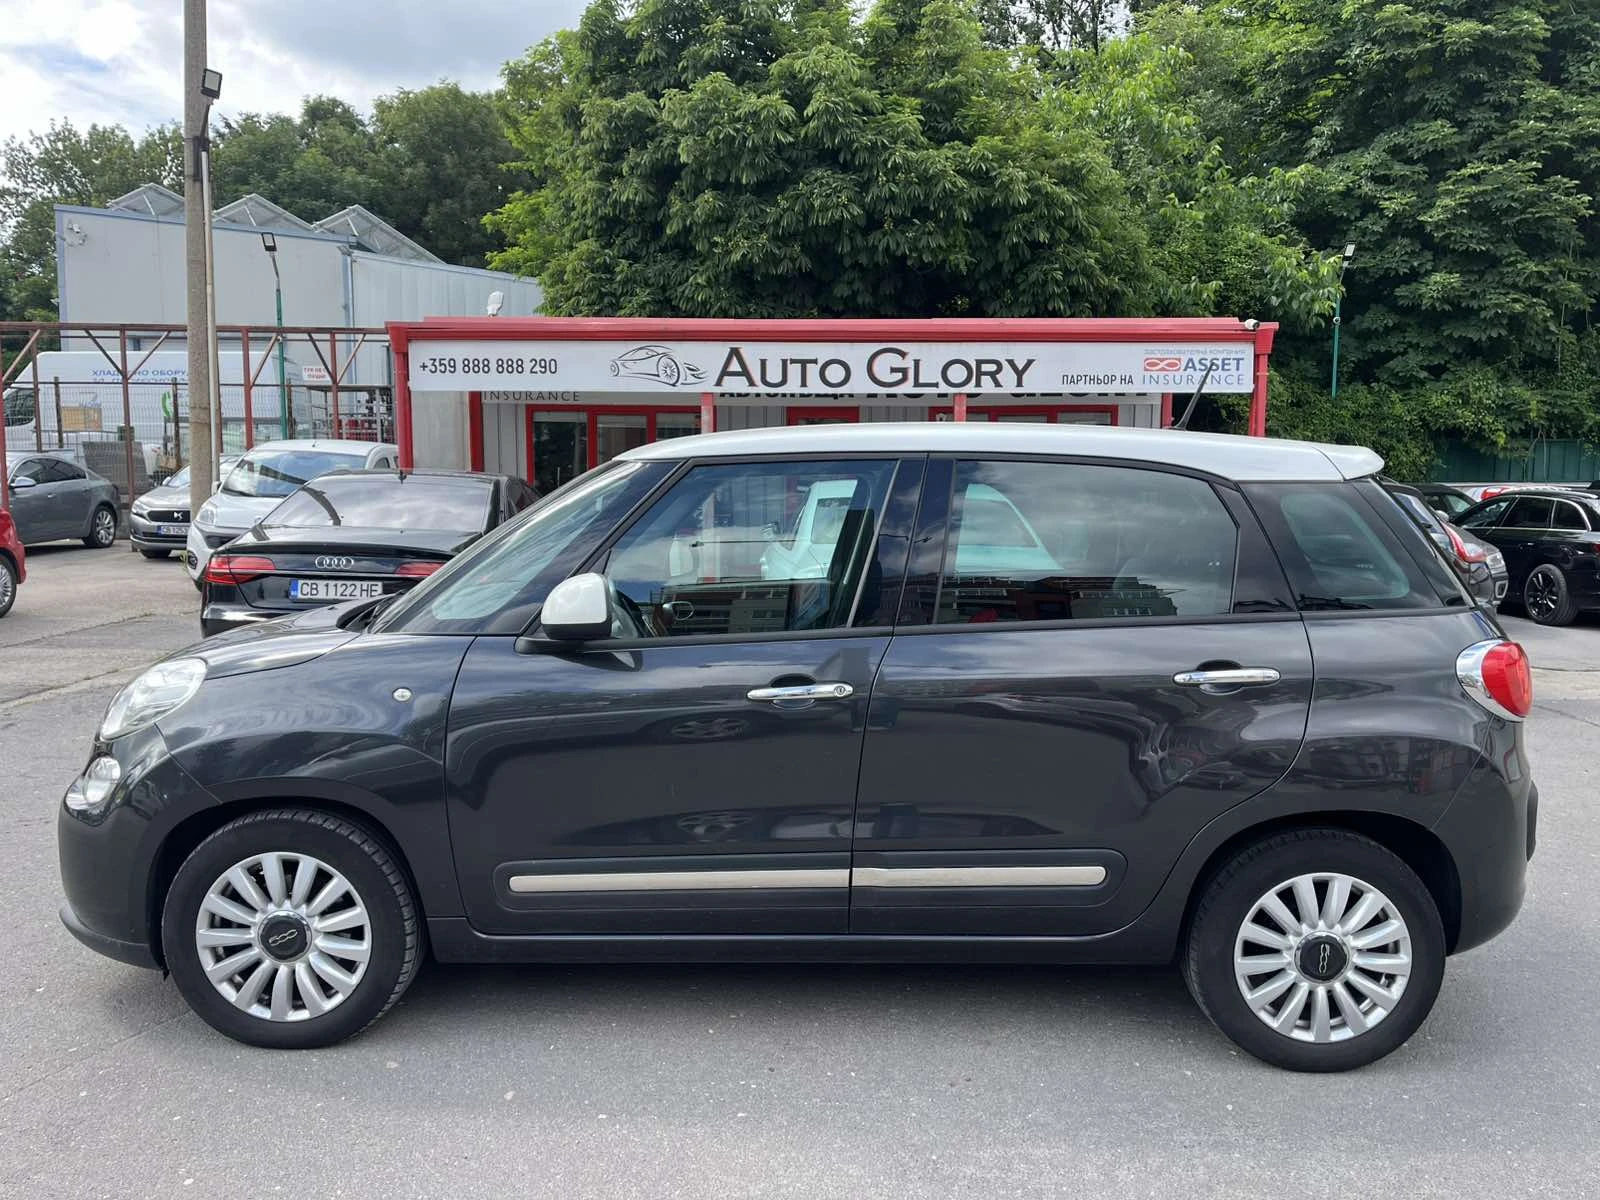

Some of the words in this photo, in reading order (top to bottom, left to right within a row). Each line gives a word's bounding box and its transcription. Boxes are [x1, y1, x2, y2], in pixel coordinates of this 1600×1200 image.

[420, 358, 457, 374] +359
[462, 358, 491, 374] 888
[496, 358, 525, 374] 888
[529, 358, 558, 374] 290
[1183, 357, 1245, 372] ASSET
[152, 369, 188, 377] ОБОРУ
[1062, 374, 1117, 385] ПАРТНЬОР
[1120, 374, 1134, 385] НА
[1142, 374, 1245, 385] INSURANCE
[483, 391, 581, 402] INSURANCE
[300, 582, 319, 597] CB
[324, 583, 357, 597] 1122
[360, 583, 379, 598] HE
